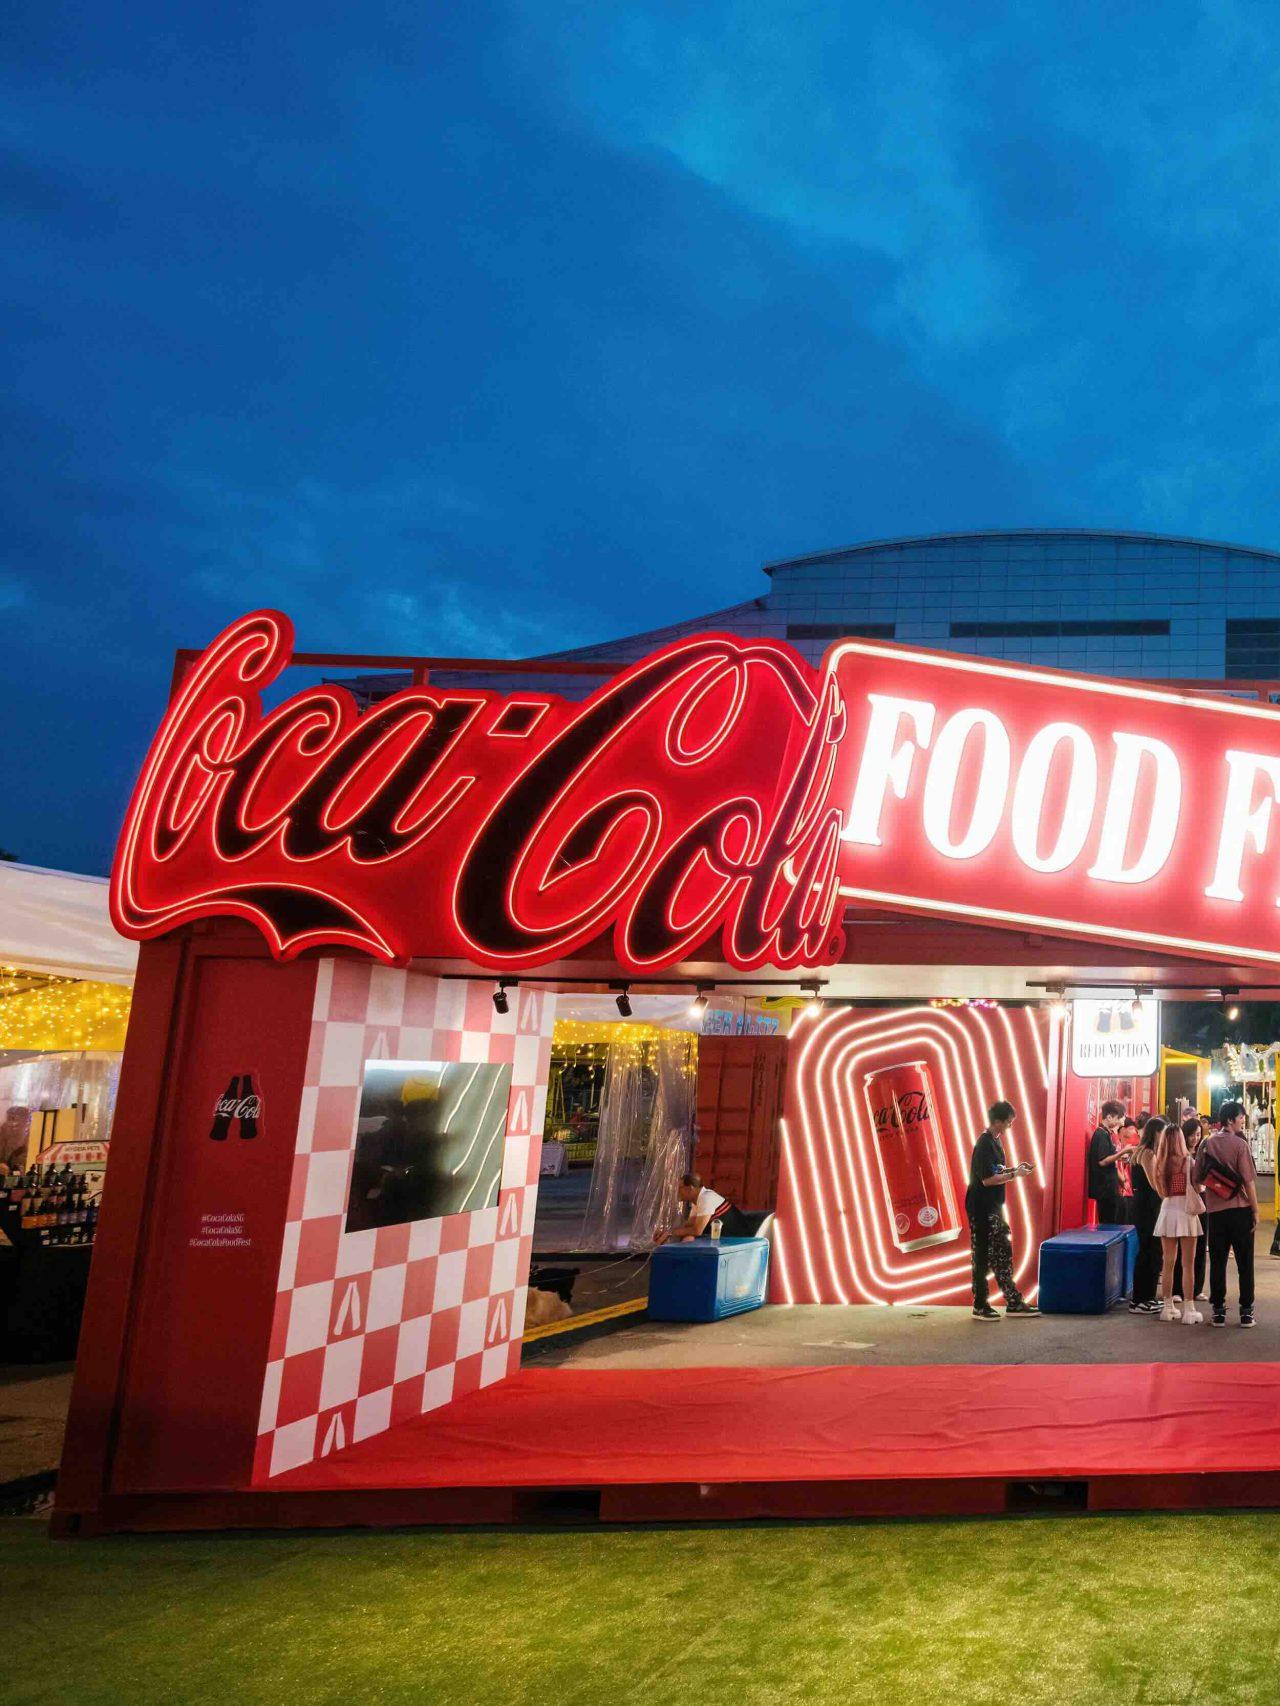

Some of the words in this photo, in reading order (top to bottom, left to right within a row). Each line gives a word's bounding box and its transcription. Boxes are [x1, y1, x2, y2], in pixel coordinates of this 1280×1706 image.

[118, 612, 847, 966] Coca-Cola
[840, 693, 1182, 884] FOOD
[1080, 1042, 1151, 1059] REDEMPTION
